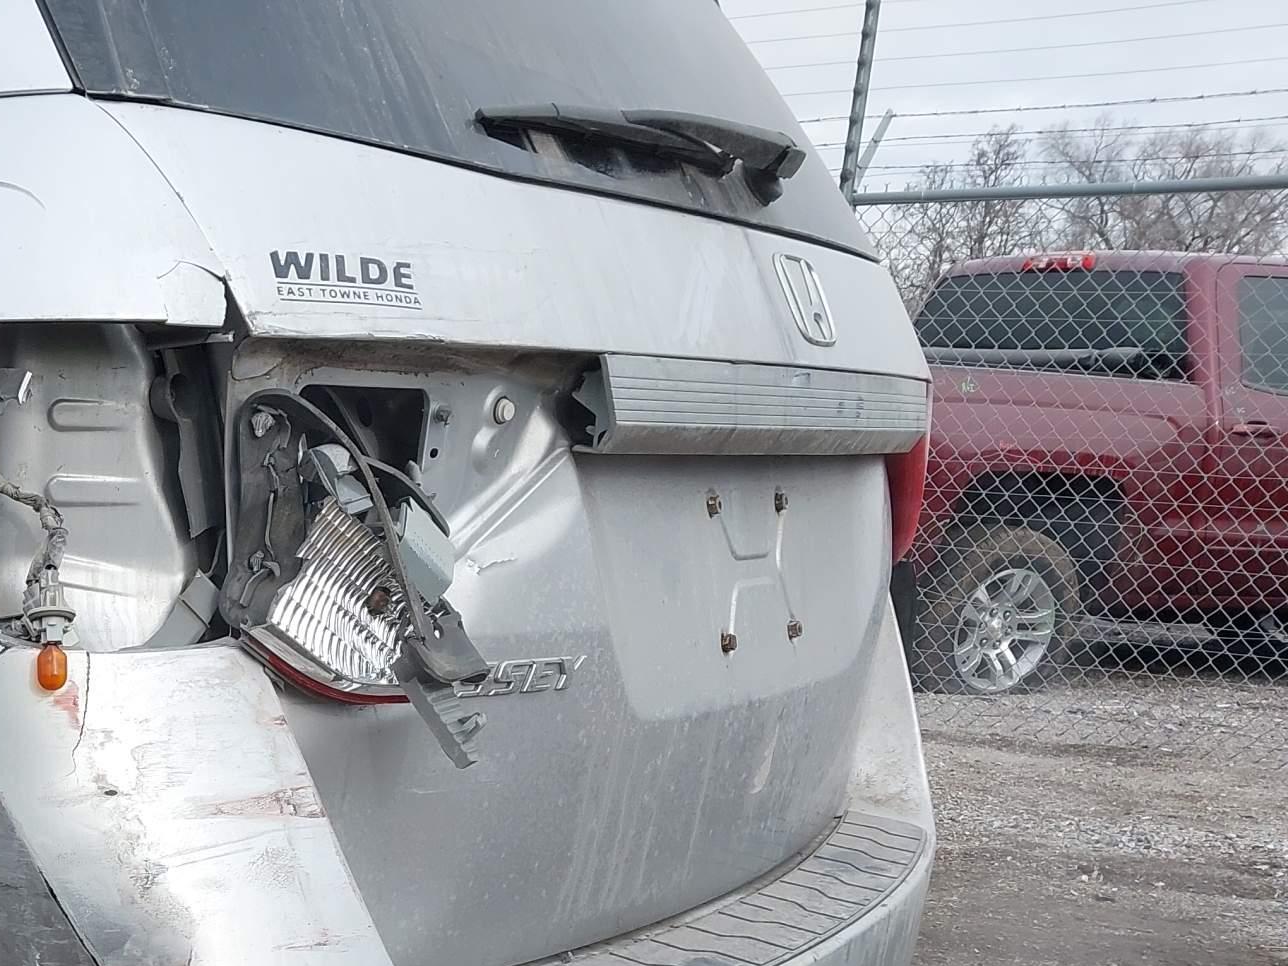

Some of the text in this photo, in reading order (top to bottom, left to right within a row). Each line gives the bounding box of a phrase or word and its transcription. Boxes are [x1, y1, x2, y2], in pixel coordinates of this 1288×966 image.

[269, 249, 414, 291] WILDE
[276, 285, 422, 306] EAST TOWNE HONDA
